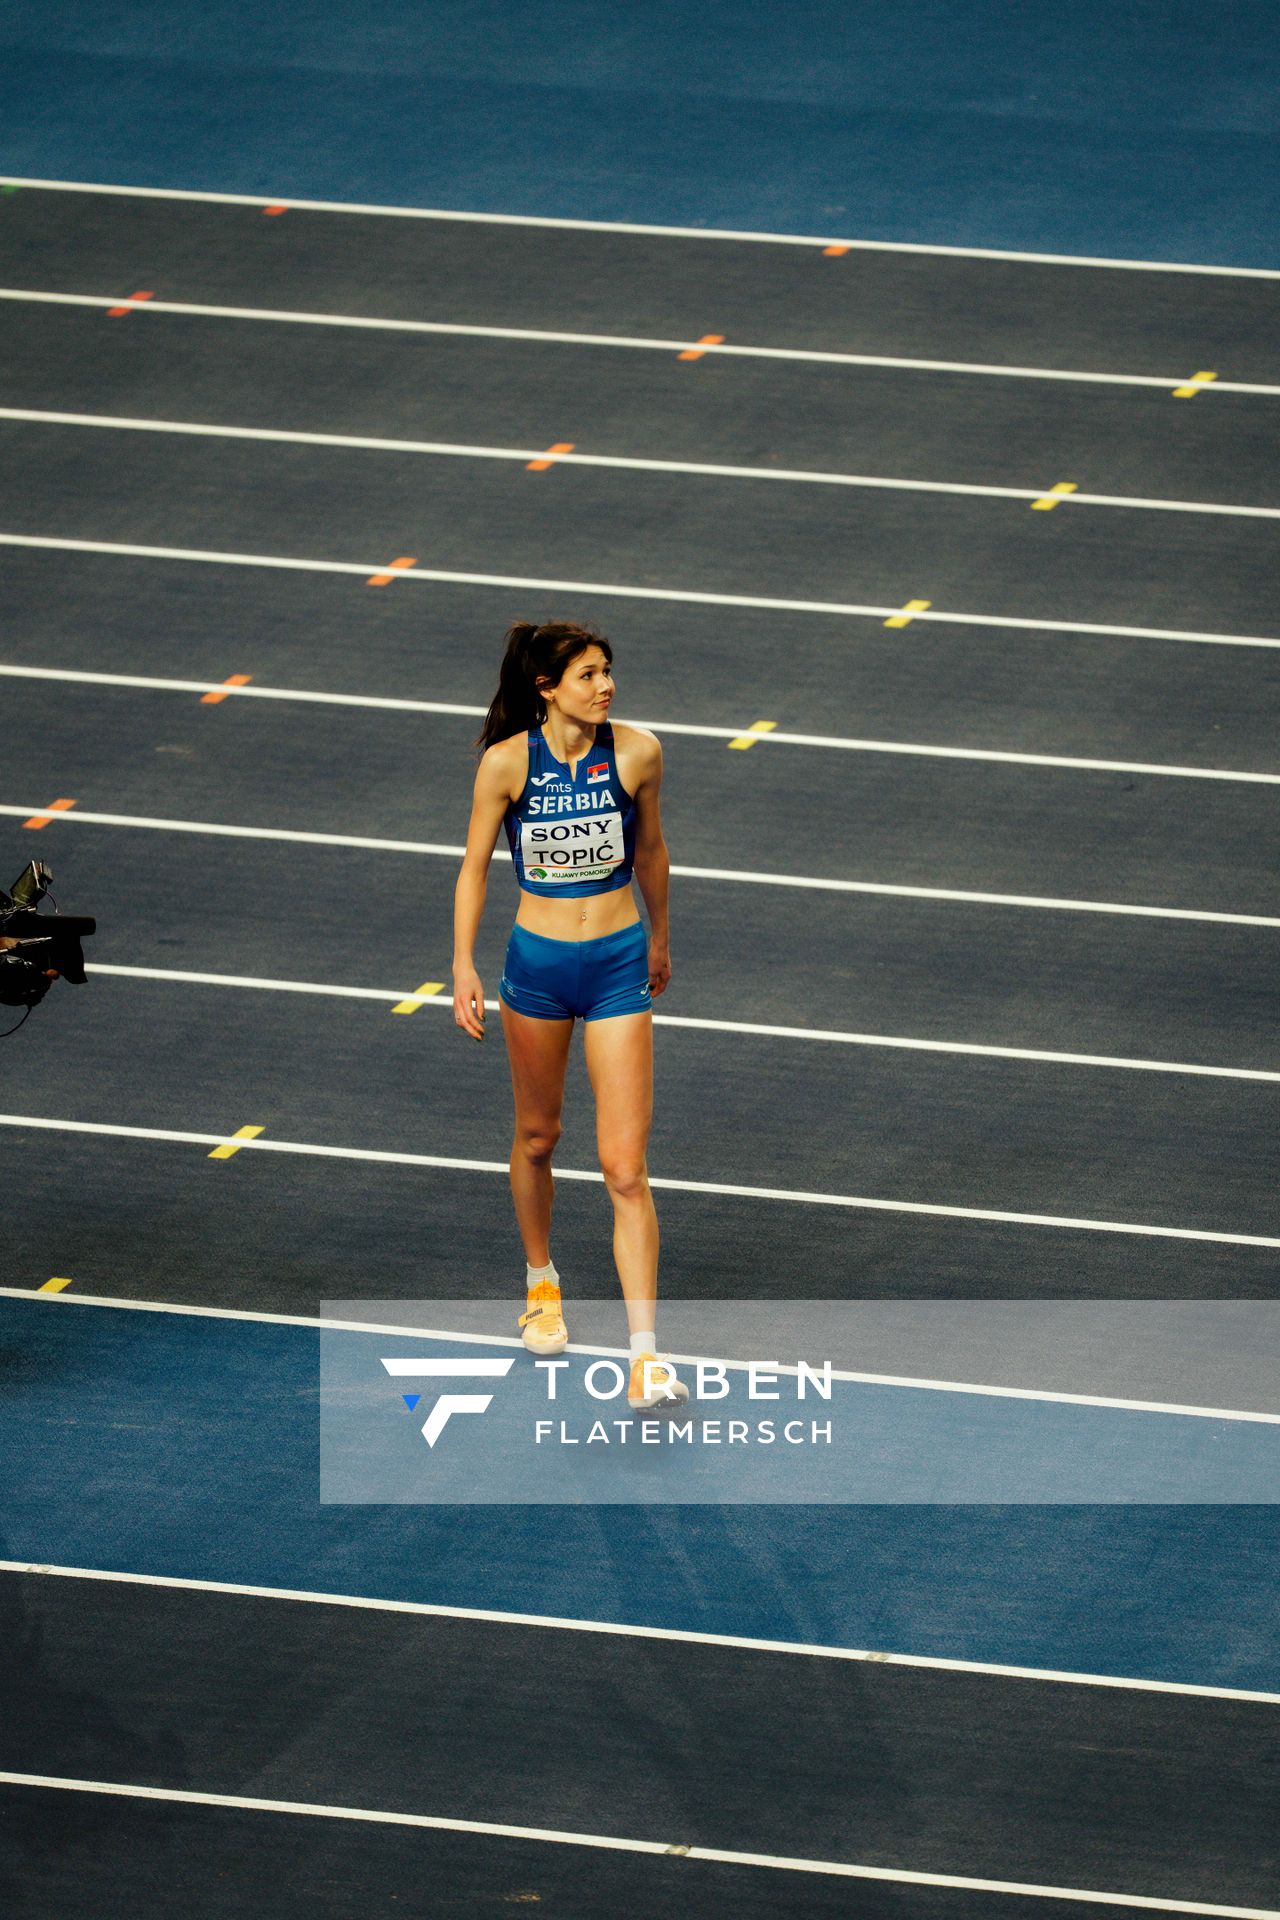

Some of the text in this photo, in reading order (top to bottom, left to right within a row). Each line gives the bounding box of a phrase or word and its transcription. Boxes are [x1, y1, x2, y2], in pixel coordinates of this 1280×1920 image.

[545, 782, 572, 793] mts
[528, 789, 616, 815] SERBIA
[531, 819, 612, 842] SONY
[532, 840, 614, 865] TOPIĆ
[579, 867, 612, 877] POMORZE
